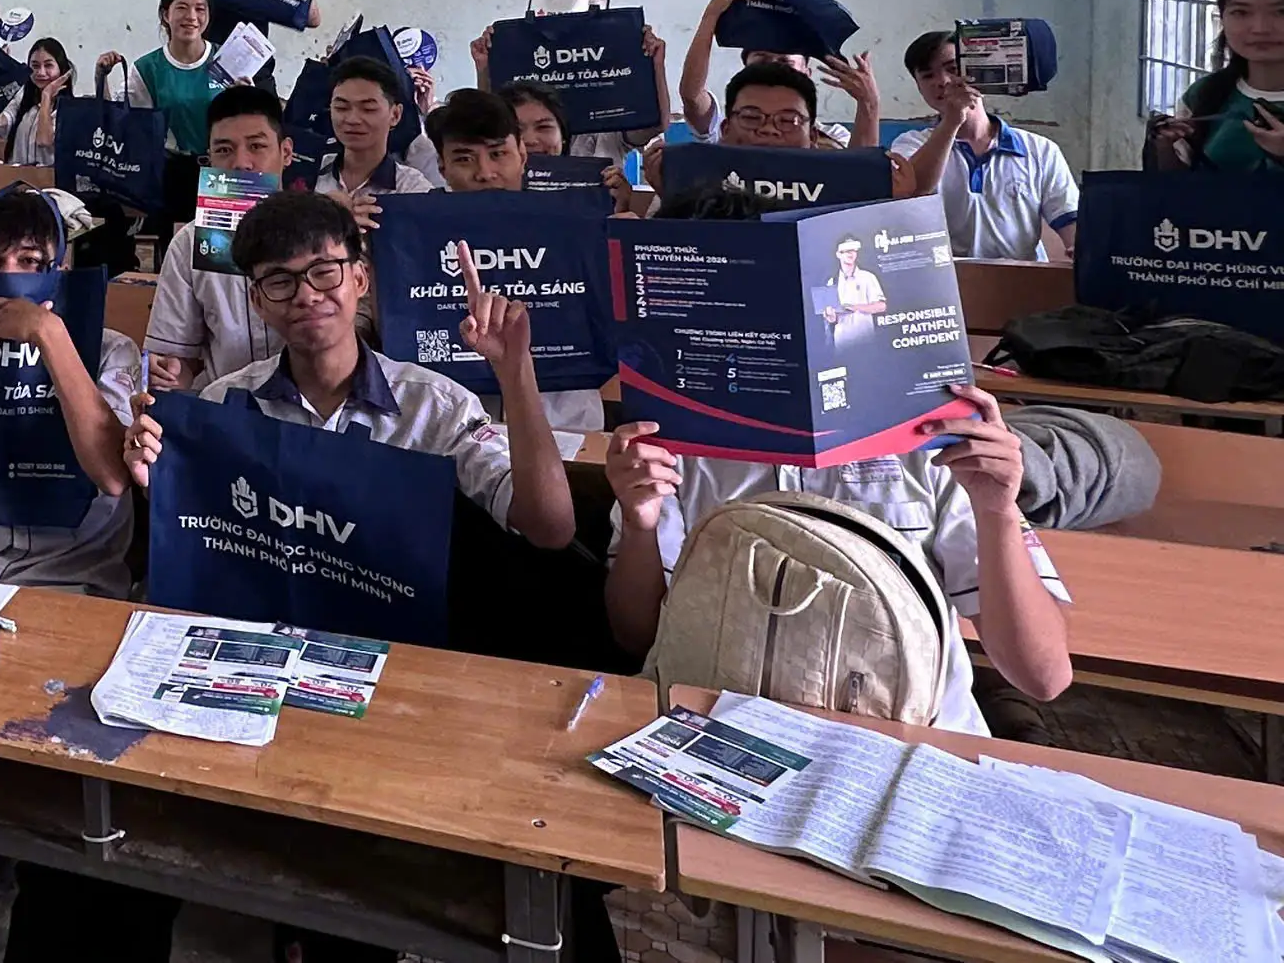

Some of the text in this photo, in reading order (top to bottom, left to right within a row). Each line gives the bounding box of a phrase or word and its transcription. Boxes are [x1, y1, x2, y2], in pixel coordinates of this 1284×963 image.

[556, 47, 605, 64] DHV
[567, 72, 575, 80] &
[577, 68, 600, 79] TỎA
[601, 66, 632, 78] SÁNG
[754, 180, 824, 202] DHV
[1188, 228, 1268, 251] DHV
[474, 247, 547, 270] DHV
[1110, 255, 1164, 269] TRƯỜNG
[1166, 259, 1190, 271] ĐẠI
[1193, 261, 1223, 274] HỌC
[1226, 262, 1267, 275] HÙNG
[635, 262, 642, 273] 1
[635, 274, 644, 284] 2
[1127, 270, 1174, 284] THÀNH
[1177, 274, 1207, 286] PHỐ
[1210, 275, 1232, 287] HỒ
[1235, 277, 1259, 289] CHÍ
[410, 281, 447, 299] KHỞI
[504, 283, 537, 296] TỎA
[540, 279, 586, 296] SÁNG
[636, 285, 645, 295] 3
[636, 296, 647, 306] 4
[638, 307, 647, 318] 5
[877, 305, 956, 326] RESPONSIBLE
[901, 318, 959, 335] FAITHFUL
[892, 330, 961, 349] CONFIDENT
[676, 349, 683, 360] 1
[726, 353, 736, 363] 4
[676, 363, 685, 374] 2
[727, 367, 737, 378] 5
[676, 378, 686, 389] 3
[728, 382, 738, 393] 6
[268, 495, 356, 544] DHV
[178, 515, 415, 598] TRƯỜNG ĐẠI HỌC HÙNG VƯƠNG
[202, 536, 392, 604] THÀNH PHỐ HỒ CHÍ MINH
